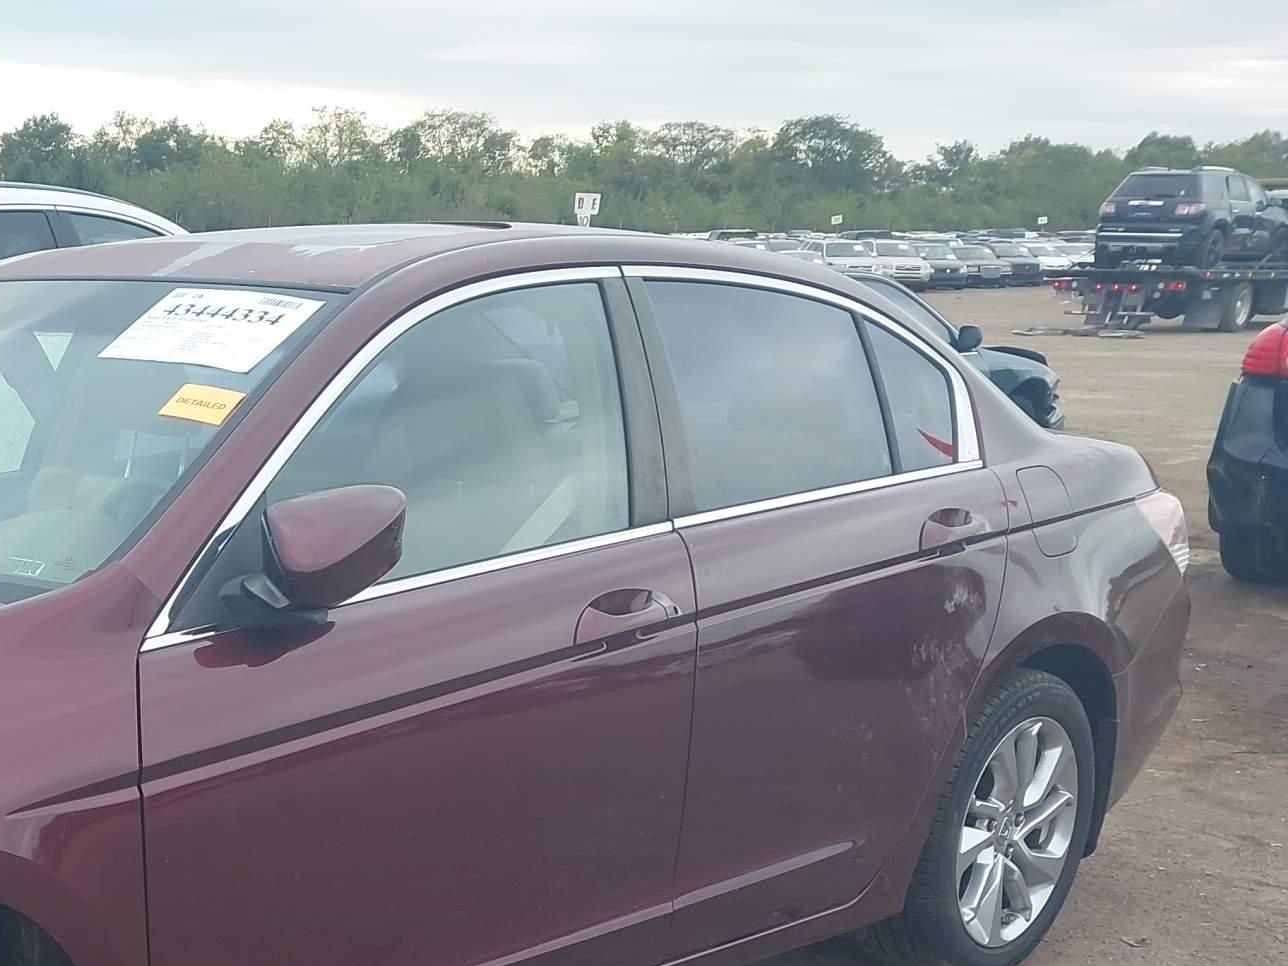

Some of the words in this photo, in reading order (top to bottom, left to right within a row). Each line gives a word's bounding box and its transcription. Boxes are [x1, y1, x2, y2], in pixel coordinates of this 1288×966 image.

[577, 196, 585, 209] D
[163, 303, 286, 325] 43444334
[175, 397, 226, 410] DETAILED
